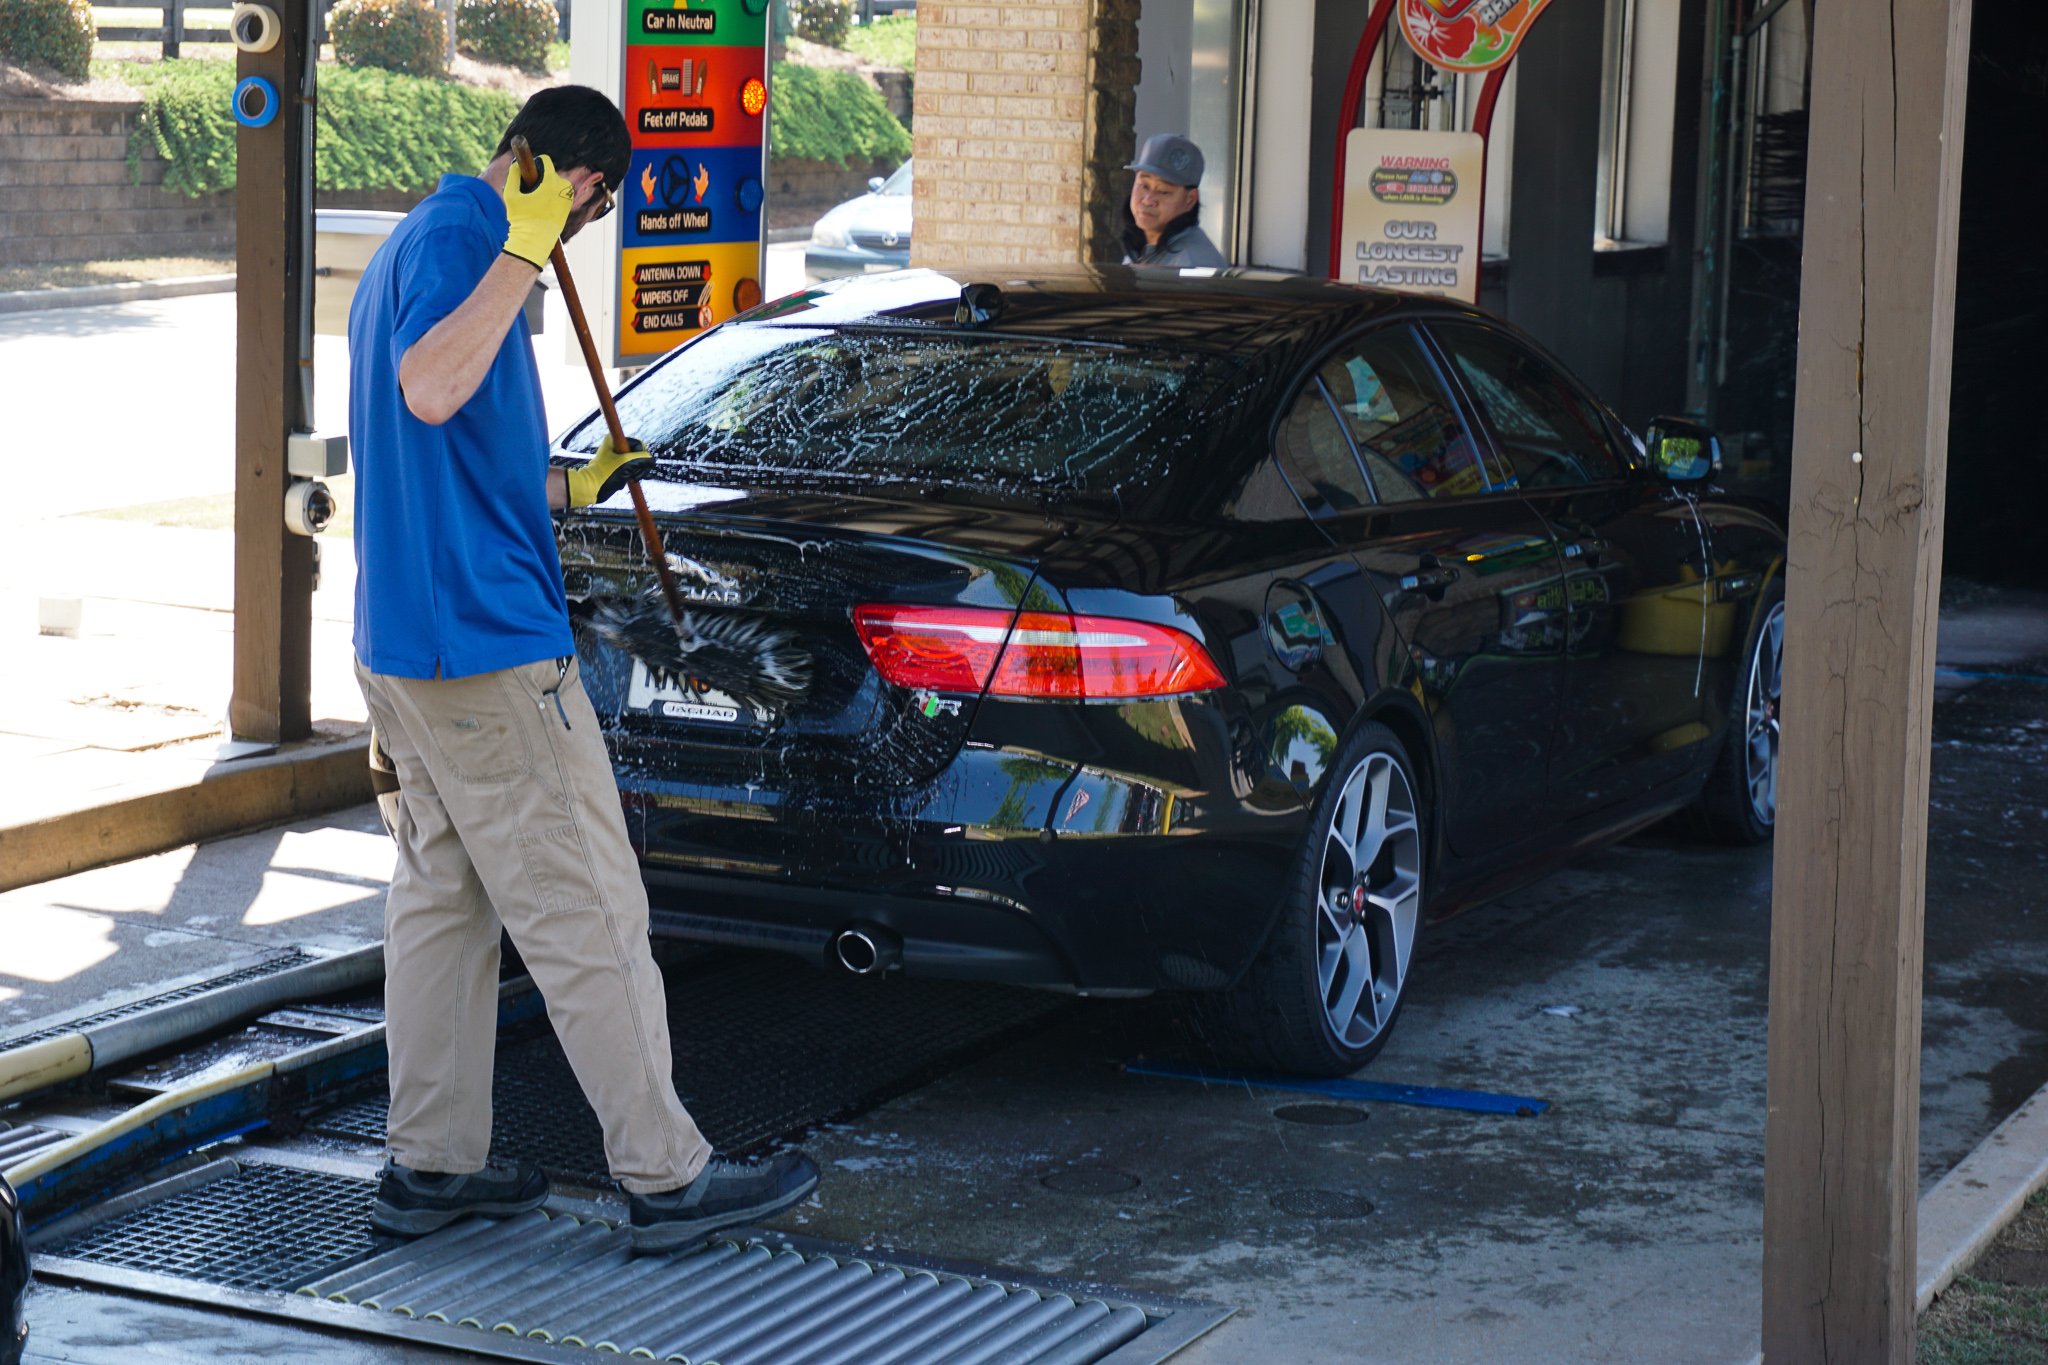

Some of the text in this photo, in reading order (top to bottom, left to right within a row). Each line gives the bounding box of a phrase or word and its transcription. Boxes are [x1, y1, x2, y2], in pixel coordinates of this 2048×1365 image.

[646, 13, 713, 30] Car in Neutral
[662, 73, 679, 84] BRAKE
[644, 112, 708, 128] Feet off Pedals
[1381, 156, 1450, 169] WARNING
[640, 212, 708, 230] Hands off Wheel
[1384, 220, 1437, 240] OUR
[1356, 241, 1463, 263] LONGEST
[640, 266, 700, 282] ANTENNA DOWN
[1359, 265, 1457, 287] LASTING
[641, 289, 688, 305] WIPERS OFF
[643, 313, 683, 329] END CALLS
[670, 704, 734, 718] JAGUAR
